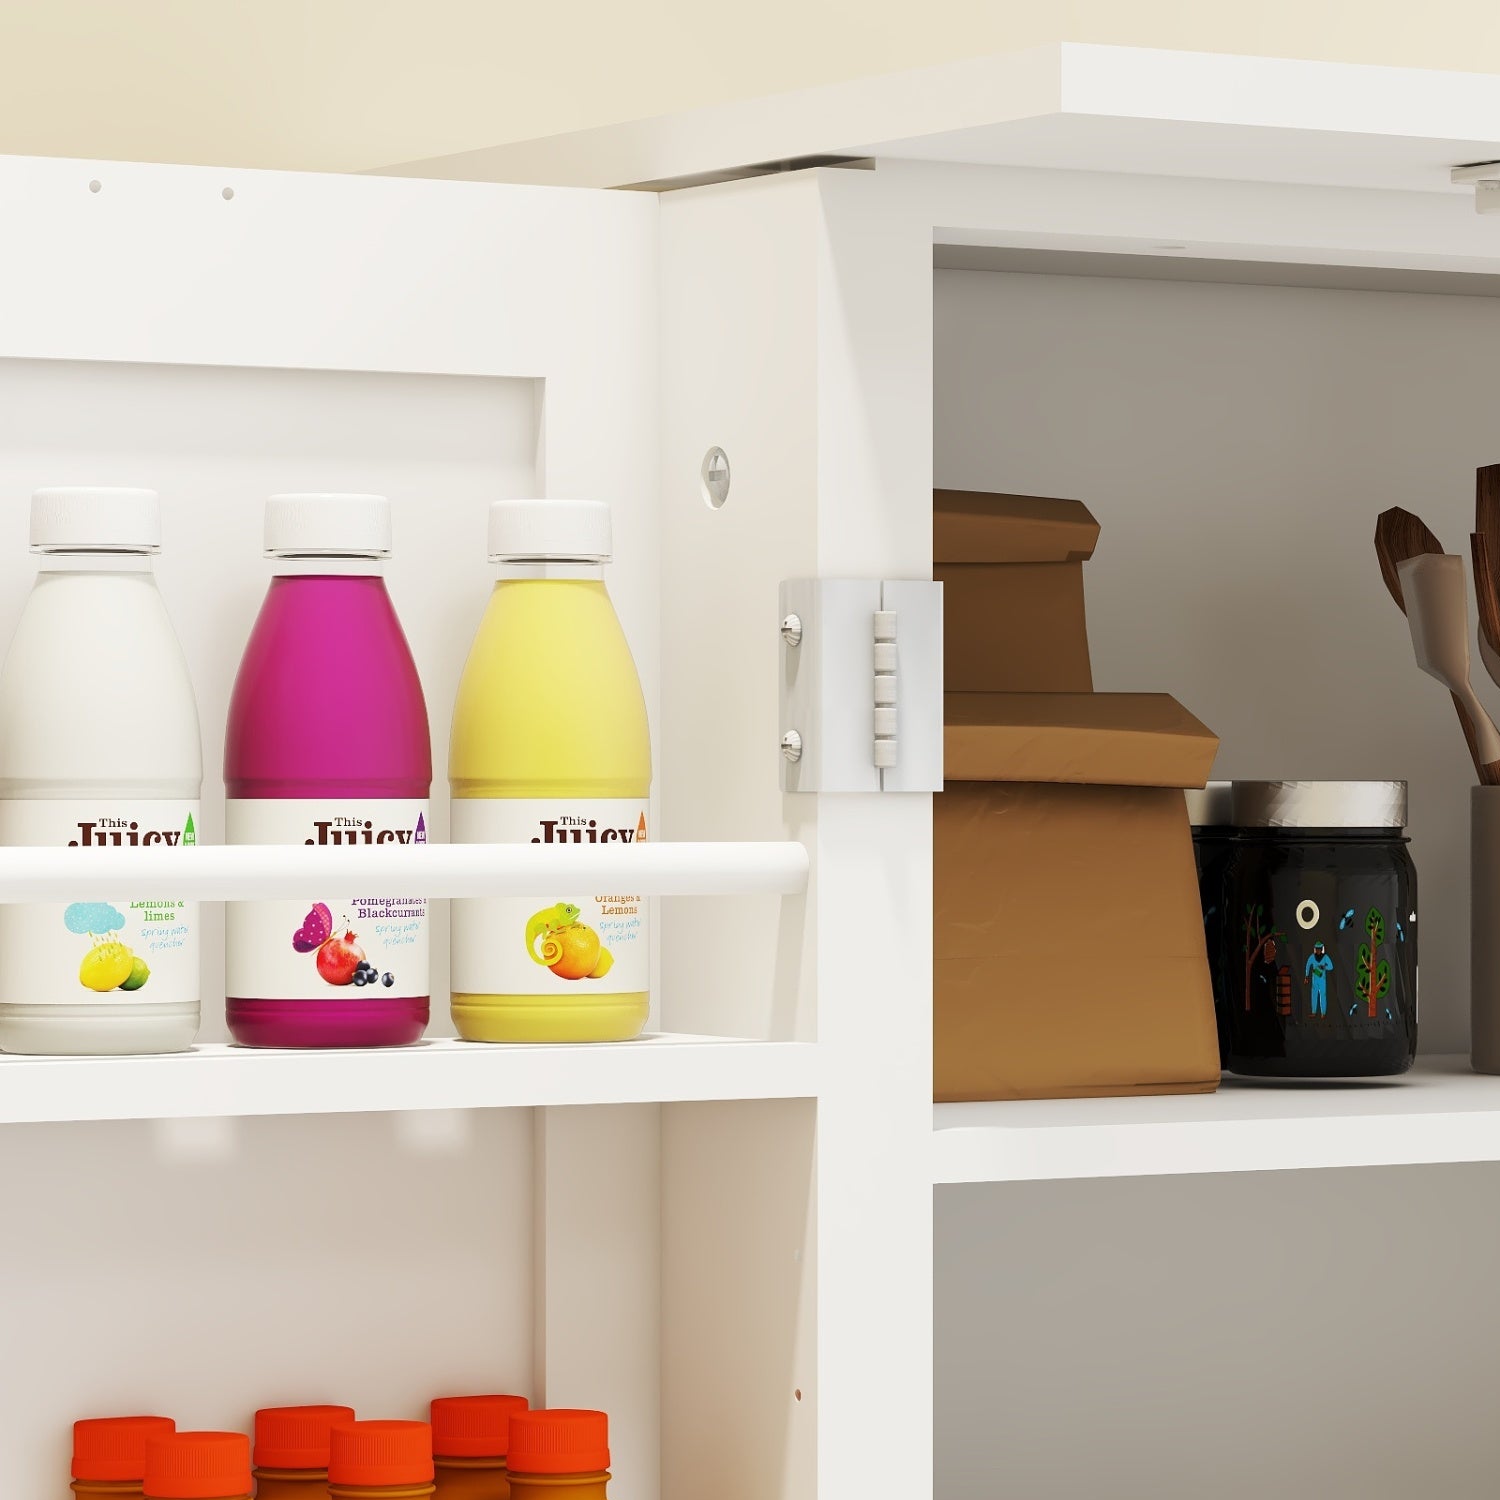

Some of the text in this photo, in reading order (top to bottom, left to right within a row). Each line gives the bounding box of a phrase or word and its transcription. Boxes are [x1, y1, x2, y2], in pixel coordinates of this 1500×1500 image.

[99, 818, 128, 828] This
[334, 817, 363, 827] This
[560, 816, 587, 826] This
[601, 905, 638, 915] Lemons
[143, 911, 175, 922] limes
